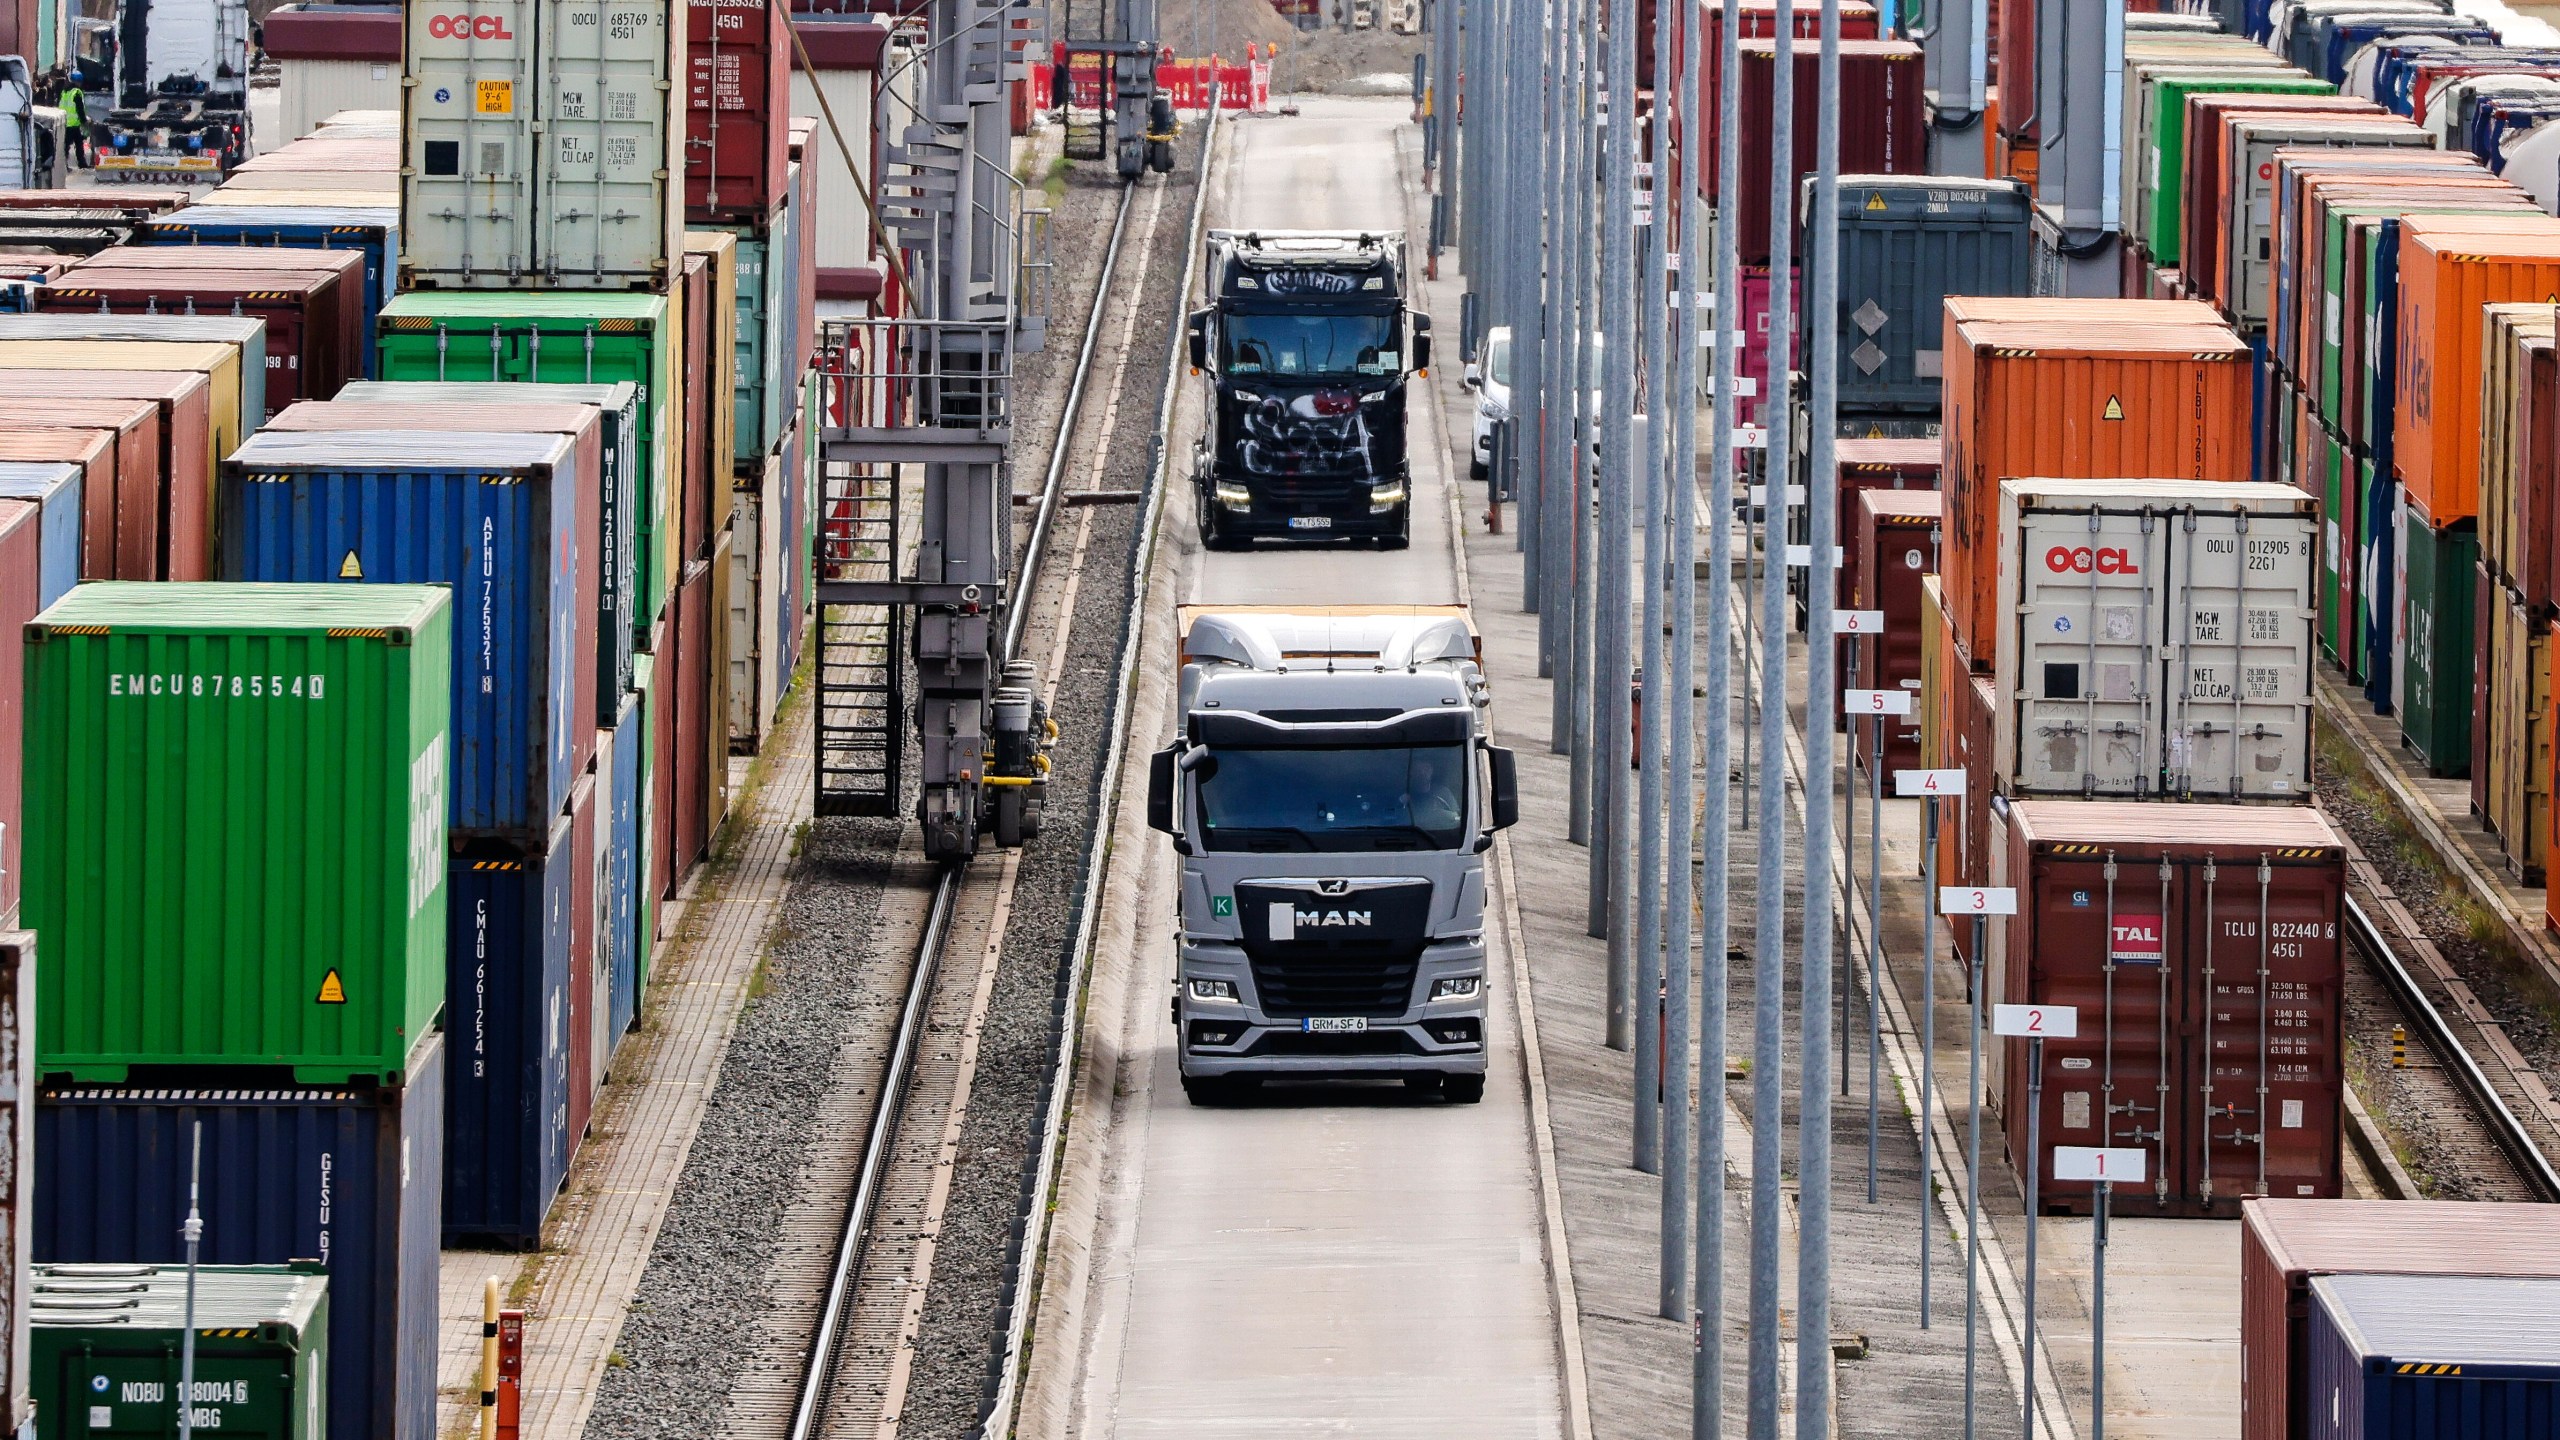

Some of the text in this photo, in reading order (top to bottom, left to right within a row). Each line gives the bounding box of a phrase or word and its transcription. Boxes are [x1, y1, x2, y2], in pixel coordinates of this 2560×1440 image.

[572, 13, 663, 26] OOCU 685769 2
[717, 14, 742, 29] 45G1
[429, 14, 512, 40] OOCL
[610, 27, 634, 39] 45G1
[694, 58, 712, 66] GROSS
[695, 72, 709, 80] TARE
[479, 82, 510, 91] CAUTION
[485, 103, 502, 111] HIGH
[1636, 164, 1648, 174] 16
[119, 171, 197, 183] VOLVO
[1668, 255, 1680, 267] 13
[369, 268, 375, 280] 7
[266, 356, 281, 368] 98
[1748, 432, 1757, 445] 9
[603, 448, 614, 610] MTQU 420004 1
[2207, 540, 2308, 556] OOLU 012905 8
[2045, 546, 2138, 574] OOCL
[2249, 556, 2275, 570] 22G1
[482, 516, 493, 693] APHU 725321 8
[1848, 614, 1858, 630] 6
[2195, 612, 2221, 626] MGW.
[2196, 627, 2223, 640] TARE.
[2194, 669, 2215, 682] NET.
[1872, 693, 1884, 710] 5
[1924, 773, 1937, 791] 4
[1972, 891, 1985, 909] 3
[2073, 891, 2088, 902] GL
[1217, 899, 1228, 914] K
[1296, 910, 1372, 927] MAN
[2112, 926, 2158, 942] TAL
[2224, 921, 2335, 938] TCLU 822440 6
[2272, 943, 2302, 958] 45G1
[474, 899, 486, 1077] CMAU 661254 3
[2217, 986, 2255, 994] MAX GROSS
[2272, 982, 2292, 990] 32.500
[2028, 1010, 2043, 1031] 2
[2275, 1009, 2292, 1018] 3.840
[1312, 1018, 1364, 1030] GRM SF 6
[2270, 1046, 2291, 1054] 63.190
[2278, 1064, 2291, 1072] 76.4
[2095, 1152, 2105, 1176] 1
[320, 1152, 331, 1225] GESU
[122, 1382, 165, 1402] NOBU
[233, 1380, 248, 1404] 6
